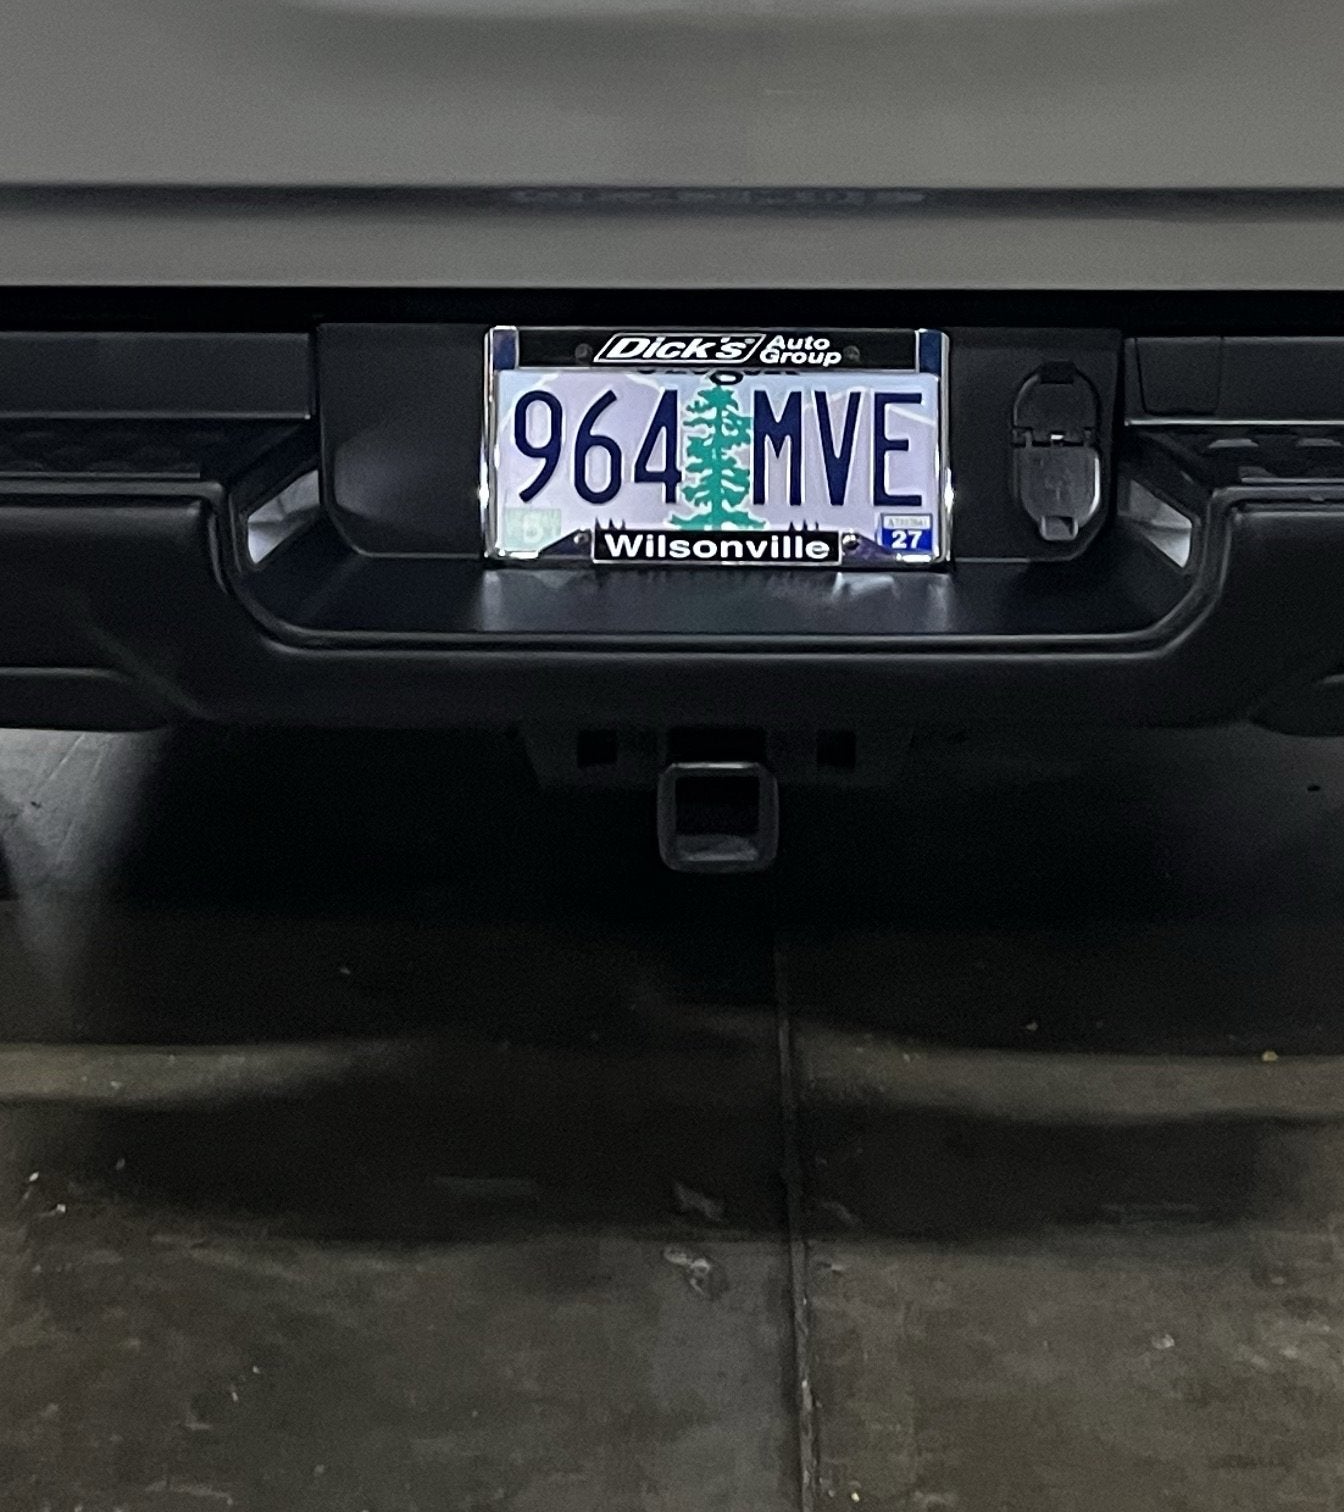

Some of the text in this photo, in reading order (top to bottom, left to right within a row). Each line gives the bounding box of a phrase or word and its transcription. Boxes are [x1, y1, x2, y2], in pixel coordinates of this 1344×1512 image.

[606, 335, 831, 360] Dick's Auto
[759, 346, 843, 367] Group
[514, 389, 923, 507] 964 MVE
[604, 534, 830, 560] Wilsonville
[891, 530, 923, 549] 27
